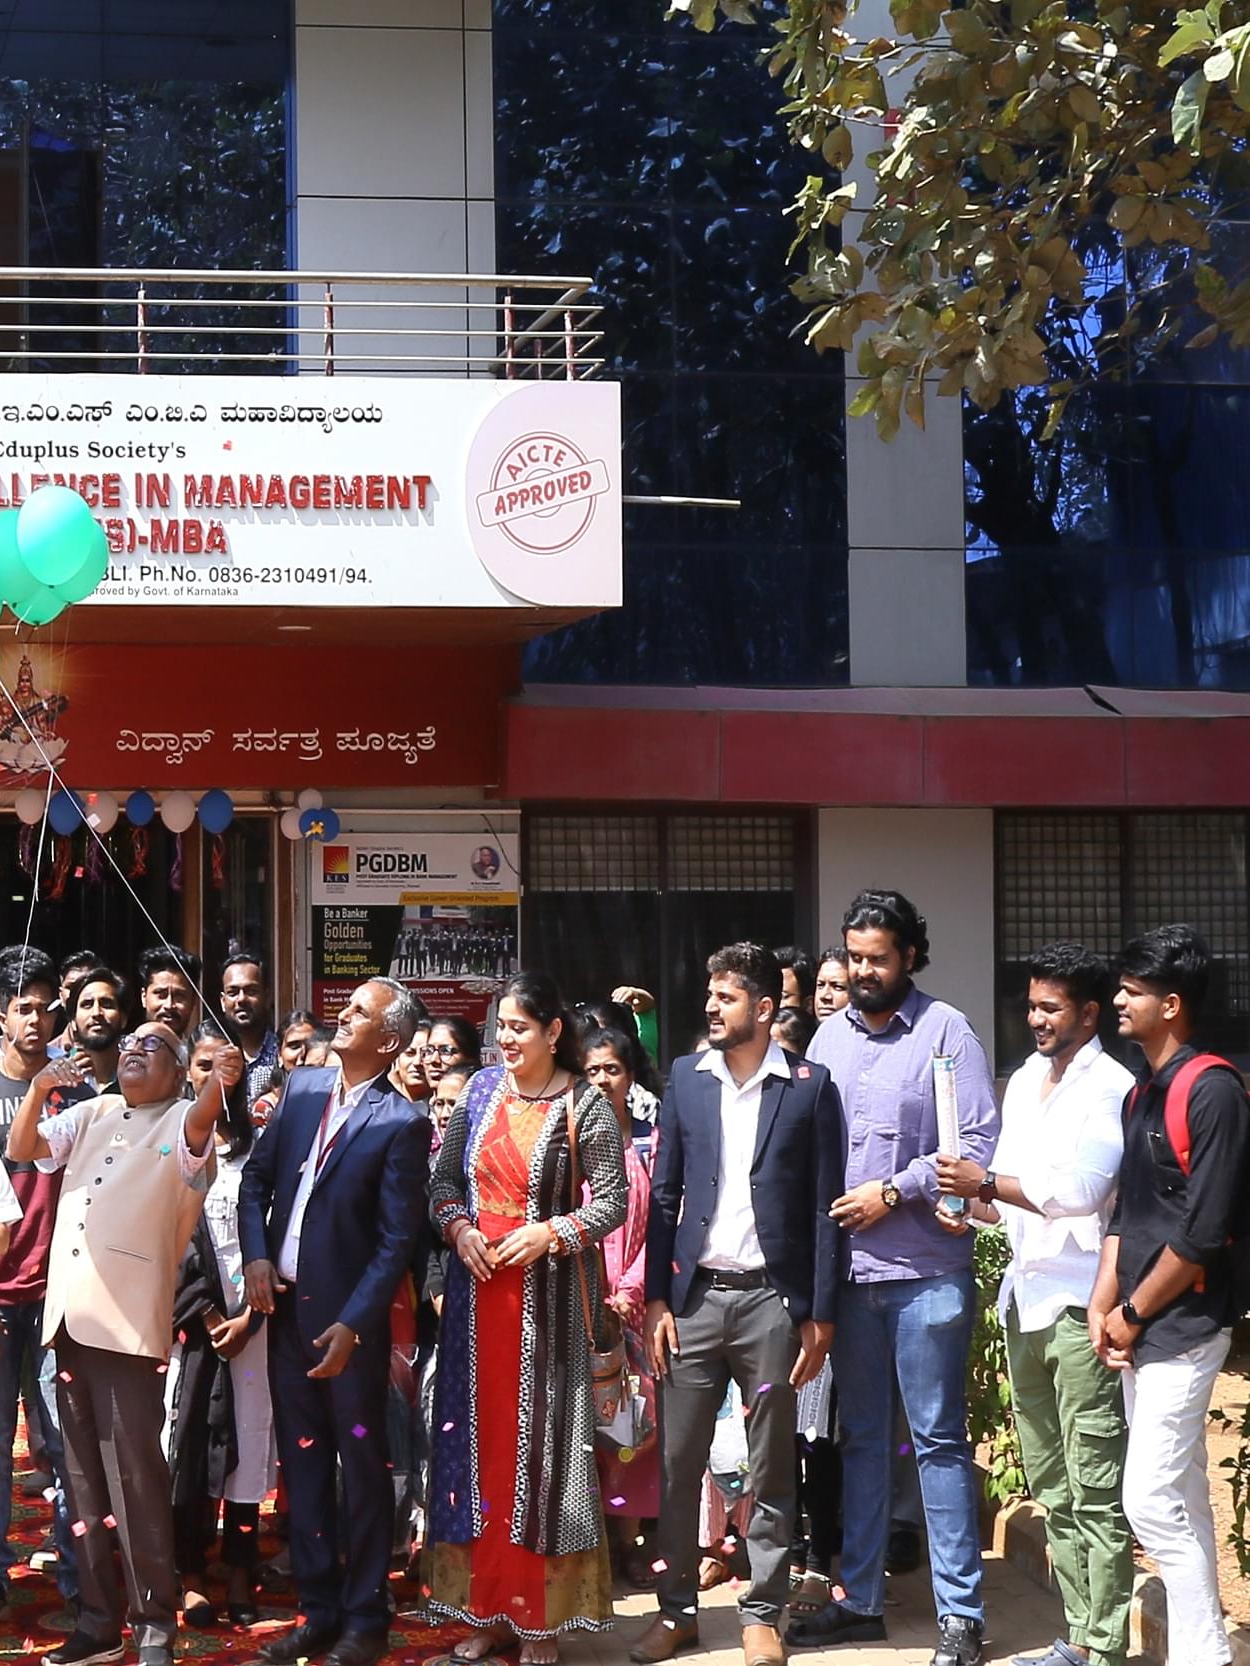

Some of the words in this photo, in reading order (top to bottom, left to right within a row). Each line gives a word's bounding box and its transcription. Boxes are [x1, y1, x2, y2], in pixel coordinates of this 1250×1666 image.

[221, 401, 383, 434] ಮಹಾವಿದ್ಯಾಲಯ
[87, 440, 186, 463] Society's
[506, 444, 567, 482] AICTE
[135, 472, 170, 508] IN
[184, 474, 432, 509] MANAGEMENT
[494, 470, 592, 516] APPROVED
[140, 566, 202, 582] Ph.No.
[209, 567, 373, 584] 0836-2310491/94.
[128, 586, 140, 597] by
[143, 586, 170, 596] Govt.
[174, 586, 184, 596] of
[187, 586, 239, 596] Karnataka
[356, 853, 428, 873] PGDBM
[324, 907, 335, 919] Be
[342, 907, 368, 919] Banker
[324, 922, 364, 939] Golden
